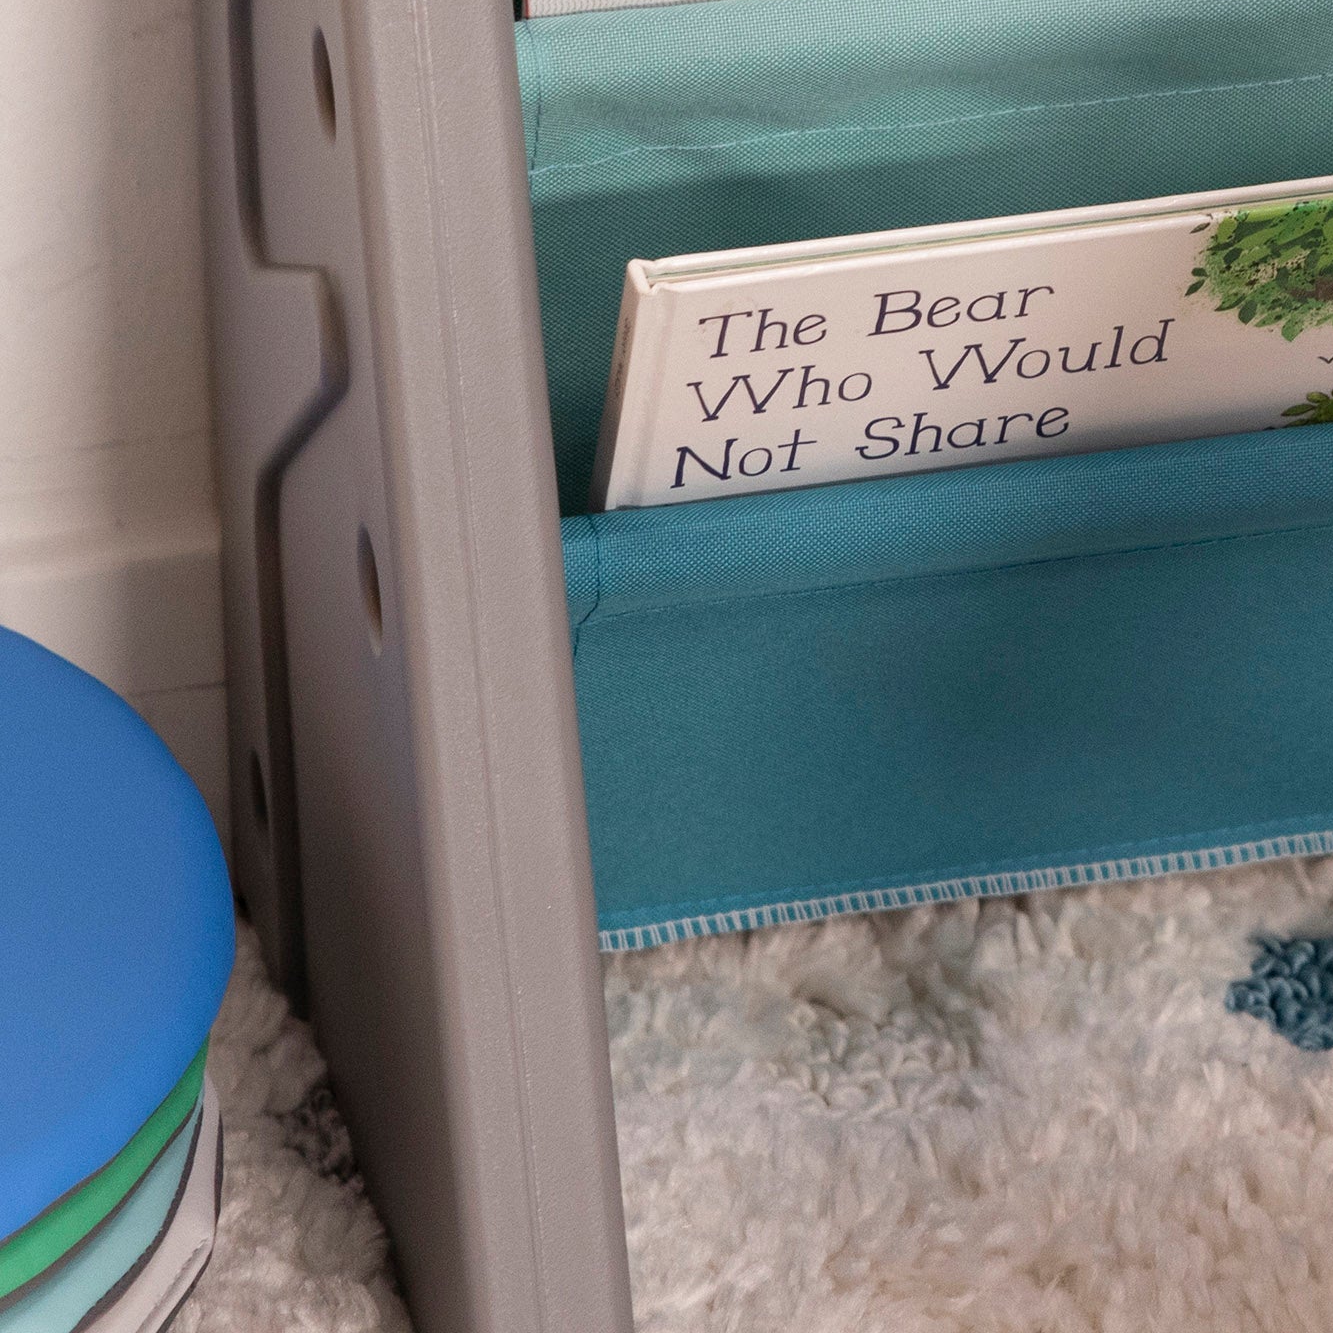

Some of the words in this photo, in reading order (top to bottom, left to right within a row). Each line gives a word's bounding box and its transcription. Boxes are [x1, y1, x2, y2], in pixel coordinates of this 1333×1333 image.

[698, 306, 828, 359] The
[866, 285, 1055, 337] Bear
[686, 364, 873, 423] Who
[918, 318, 1176, 392] Would
[670, 427, 819, 490] Not
[854, 405, 1070, 463] Share
